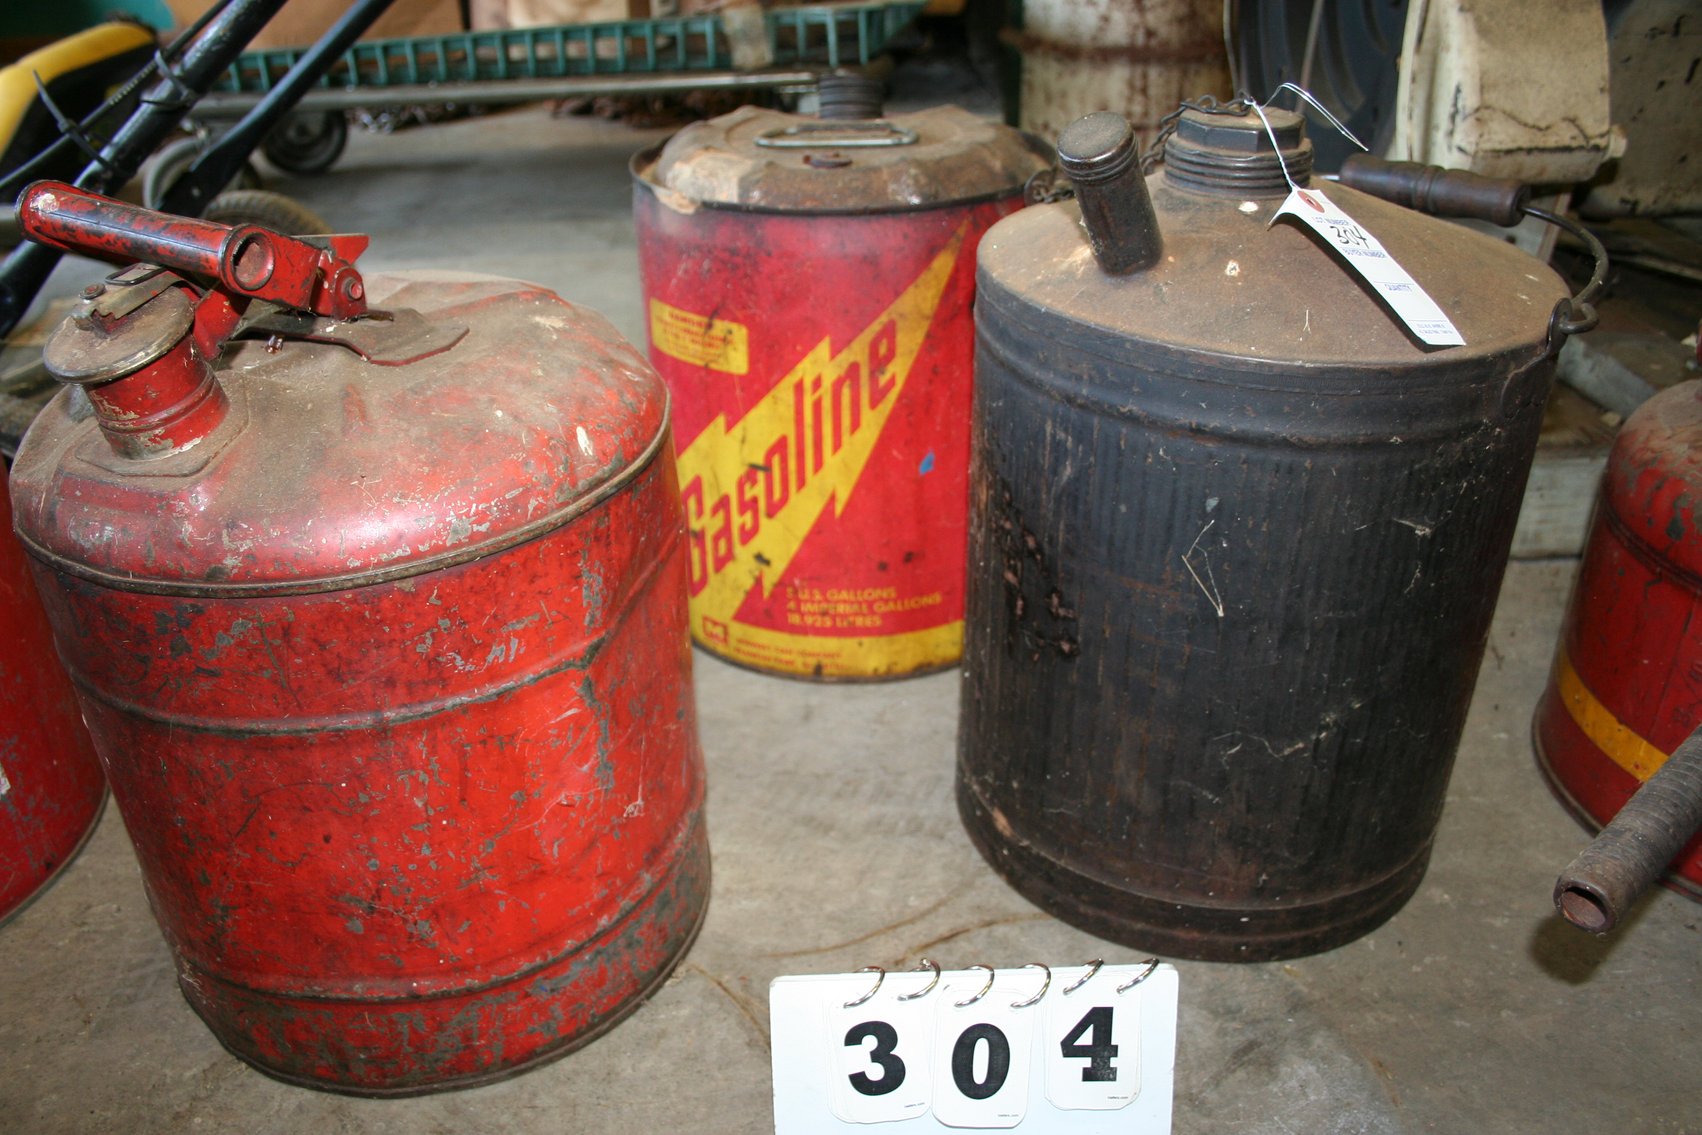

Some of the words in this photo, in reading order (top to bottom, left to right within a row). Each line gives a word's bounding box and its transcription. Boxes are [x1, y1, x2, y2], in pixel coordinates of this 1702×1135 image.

[1329, 225, 1370, 249] 304
[681, 318, 897, 598] Gasoline
[800, 601, 868, 614] IMPERIAL
[873, 591, 943, 614] GALLONS
[826, 586, 897, 601] GALLONS
